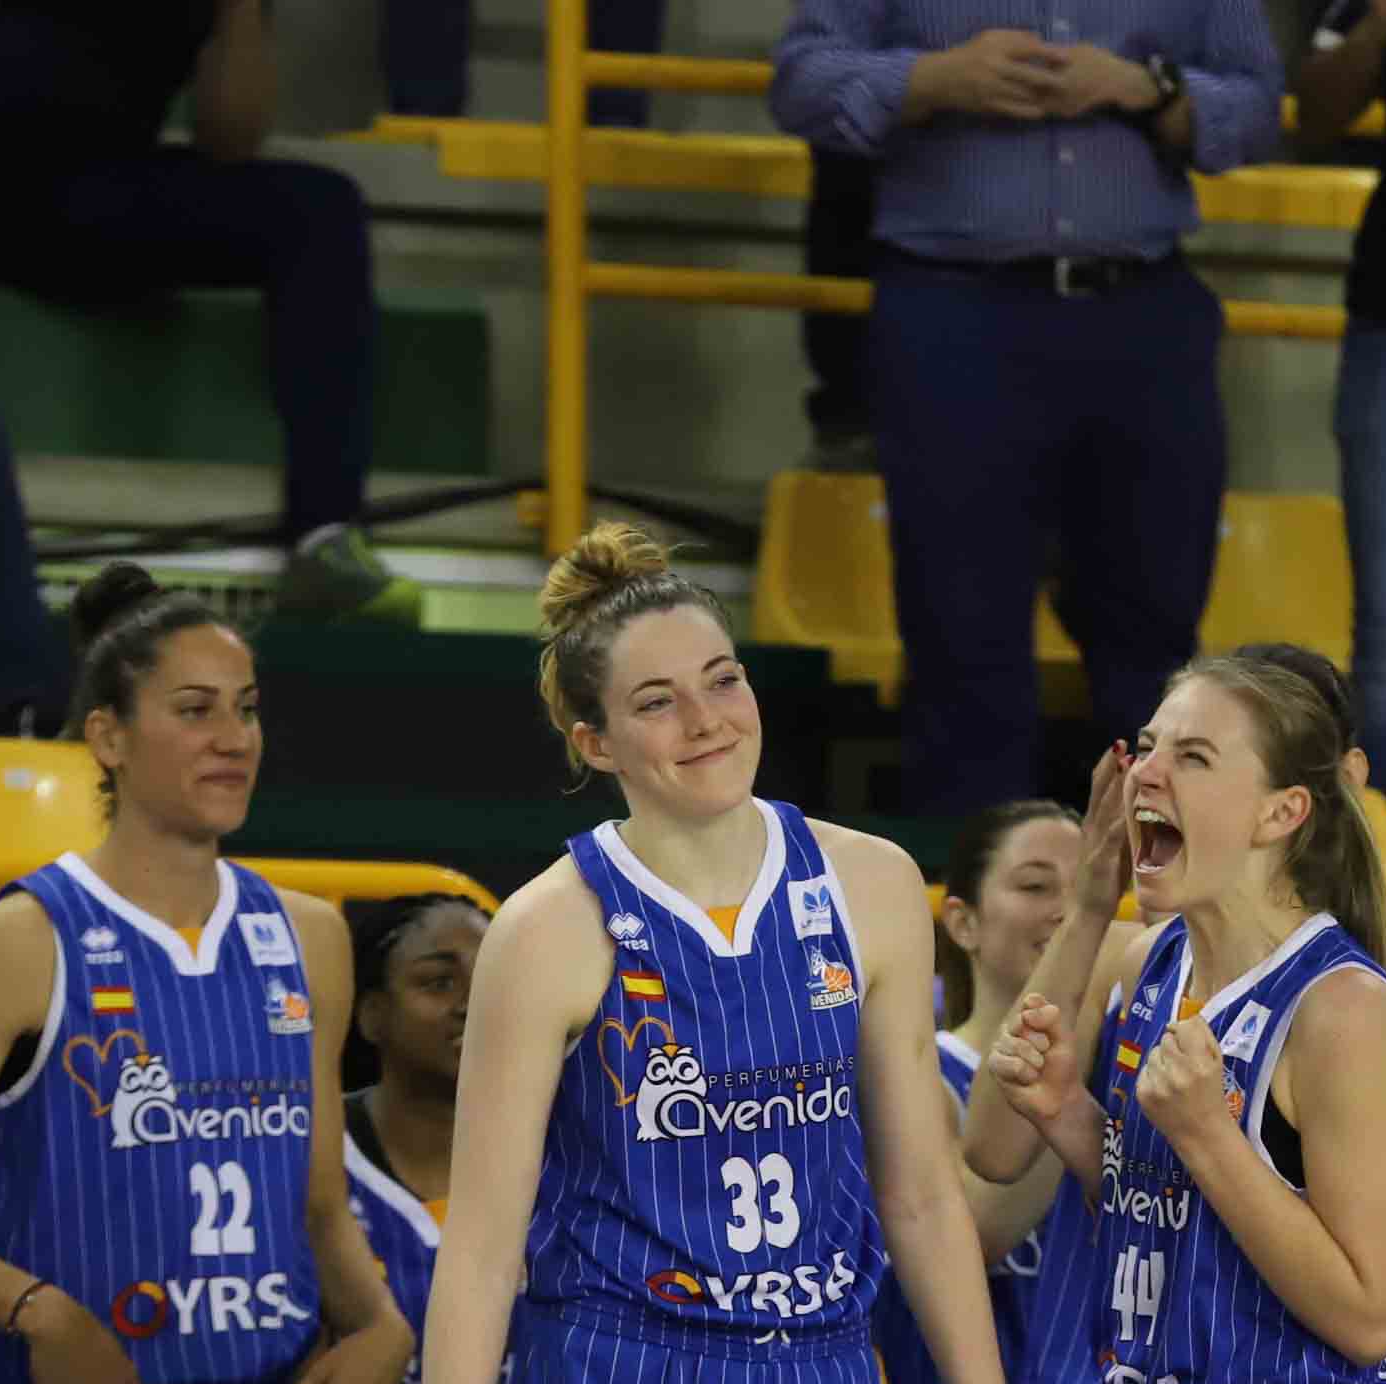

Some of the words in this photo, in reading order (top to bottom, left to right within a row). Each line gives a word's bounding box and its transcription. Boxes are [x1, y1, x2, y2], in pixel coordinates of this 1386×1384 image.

[190, 1161, 255, 1257] 22
[720, 1153, 800, 1253] 33
[1111, 1245, 1164, 1346] 44
